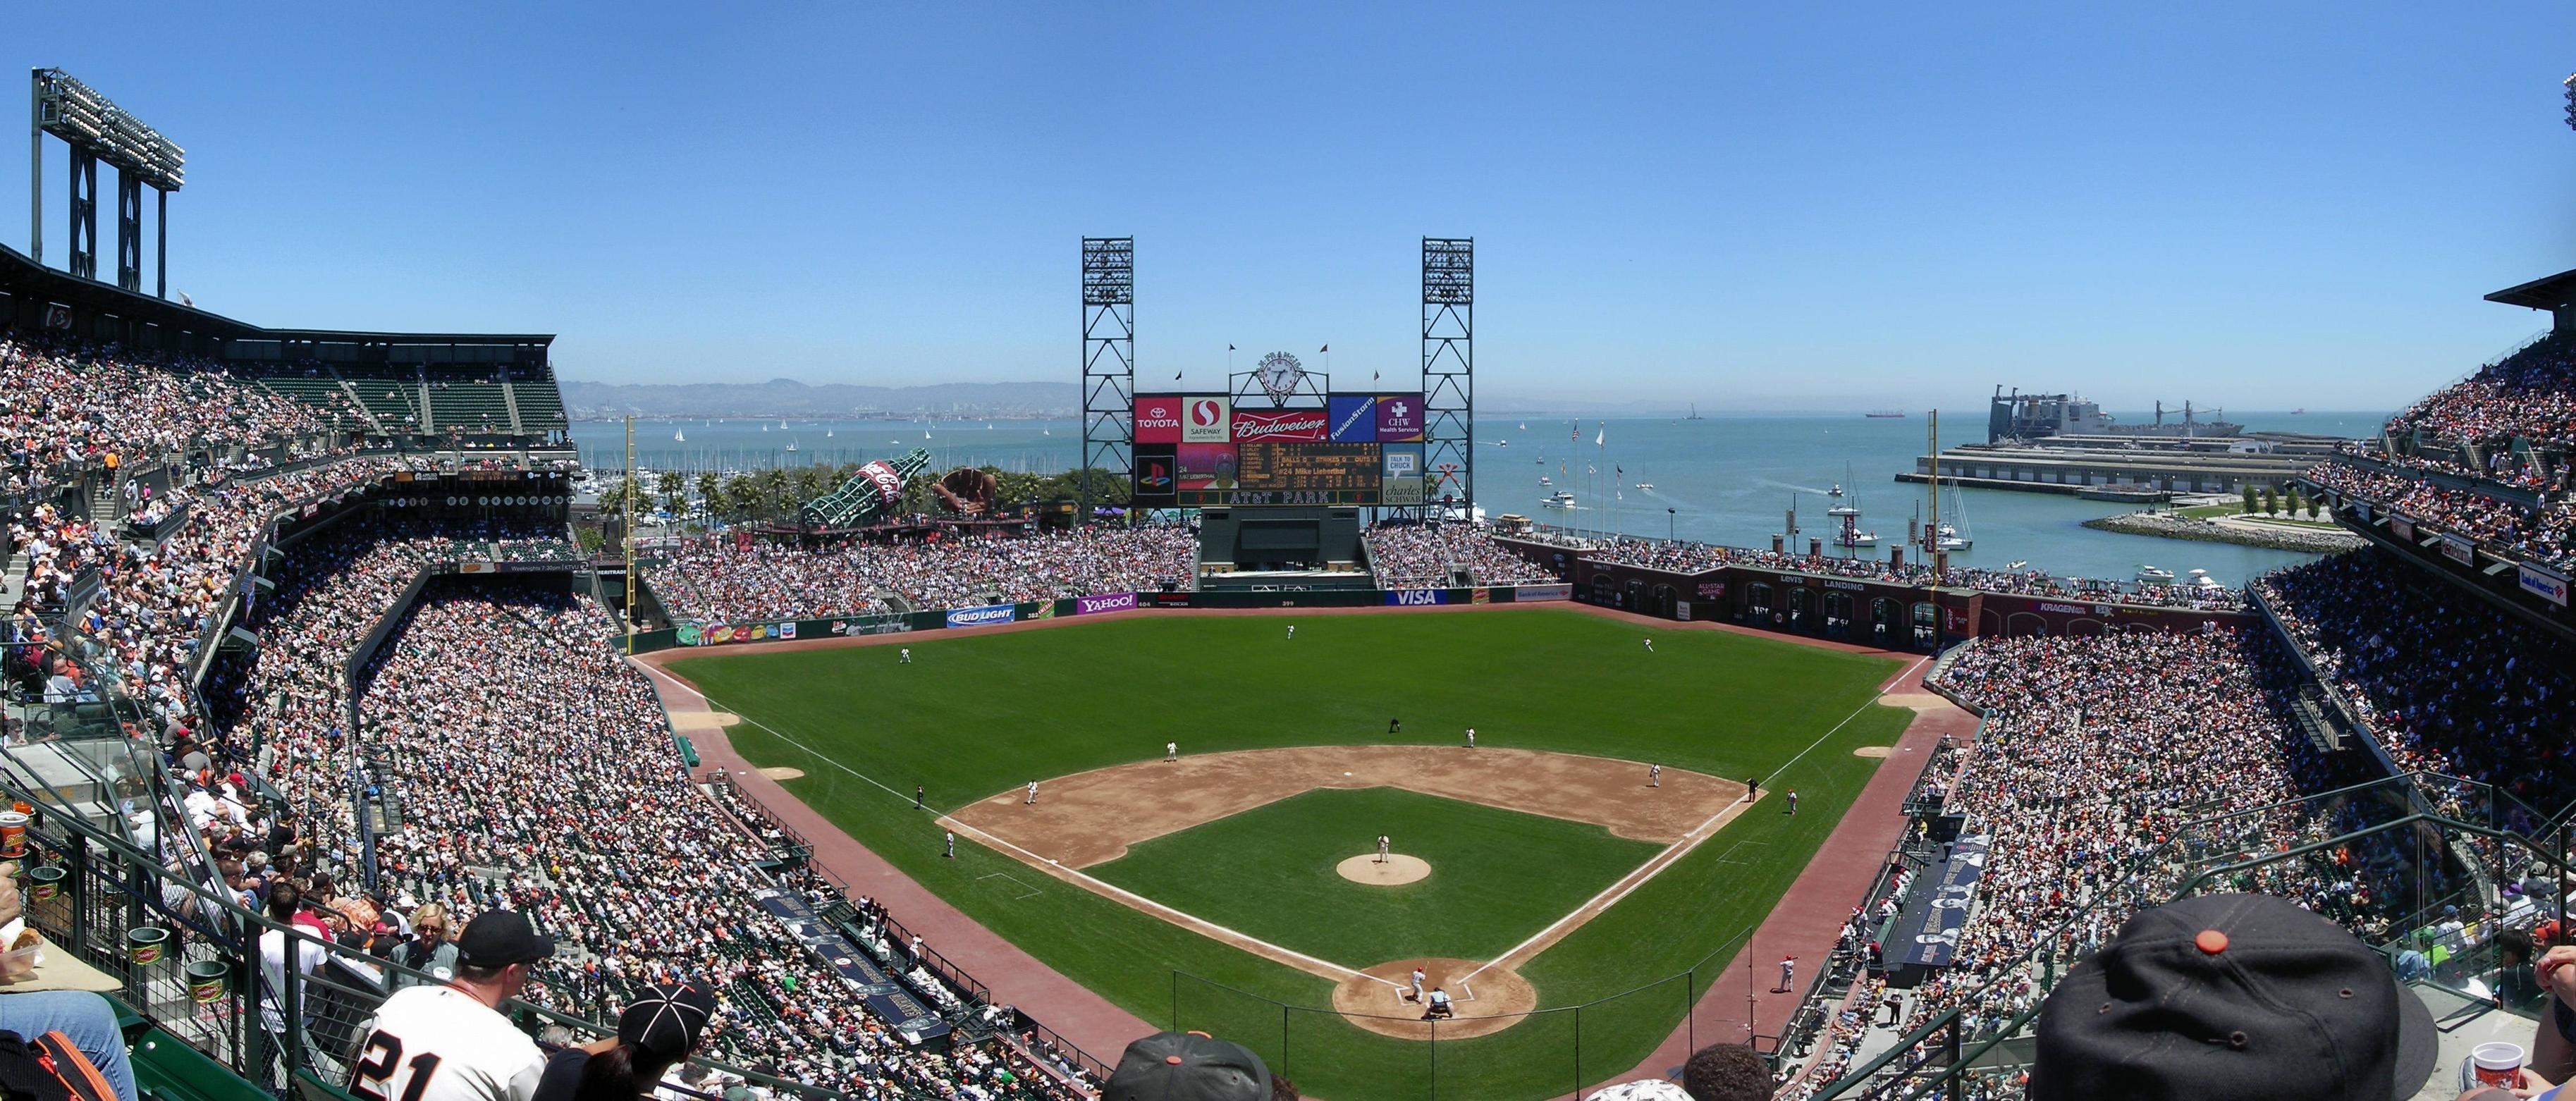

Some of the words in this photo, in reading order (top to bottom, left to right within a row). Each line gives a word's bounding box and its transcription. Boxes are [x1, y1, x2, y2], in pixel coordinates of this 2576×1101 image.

[1137, 419, 1179, 428] TOYOTA
[1330, 397, 1375, 441] FusionStorm
[1388, 418, 1410, 426] CHW
[1232, 418, 1325, 438] Budweiser
[1385, 484, 1421, 496] charles
[1229, 491, 1272, 504] AT&T
[1283, 491, 1330, 504] PARK
[1824, 579, 1864, 591] LANDING
[1082, 594, 1133, 613] YAHOO!
[1397, 590, 1436, 605] VISA
[2040, 603, 2075, 614] KRAGEN
[955, 613, 979, 622] BUD
[981, 609, 1013, 620] LIGHT
[137, 949, 159, 959] DIAMOND
[197, 985, 219, 997] DIAMOND
[348, 1028, 443, 1101] 21
